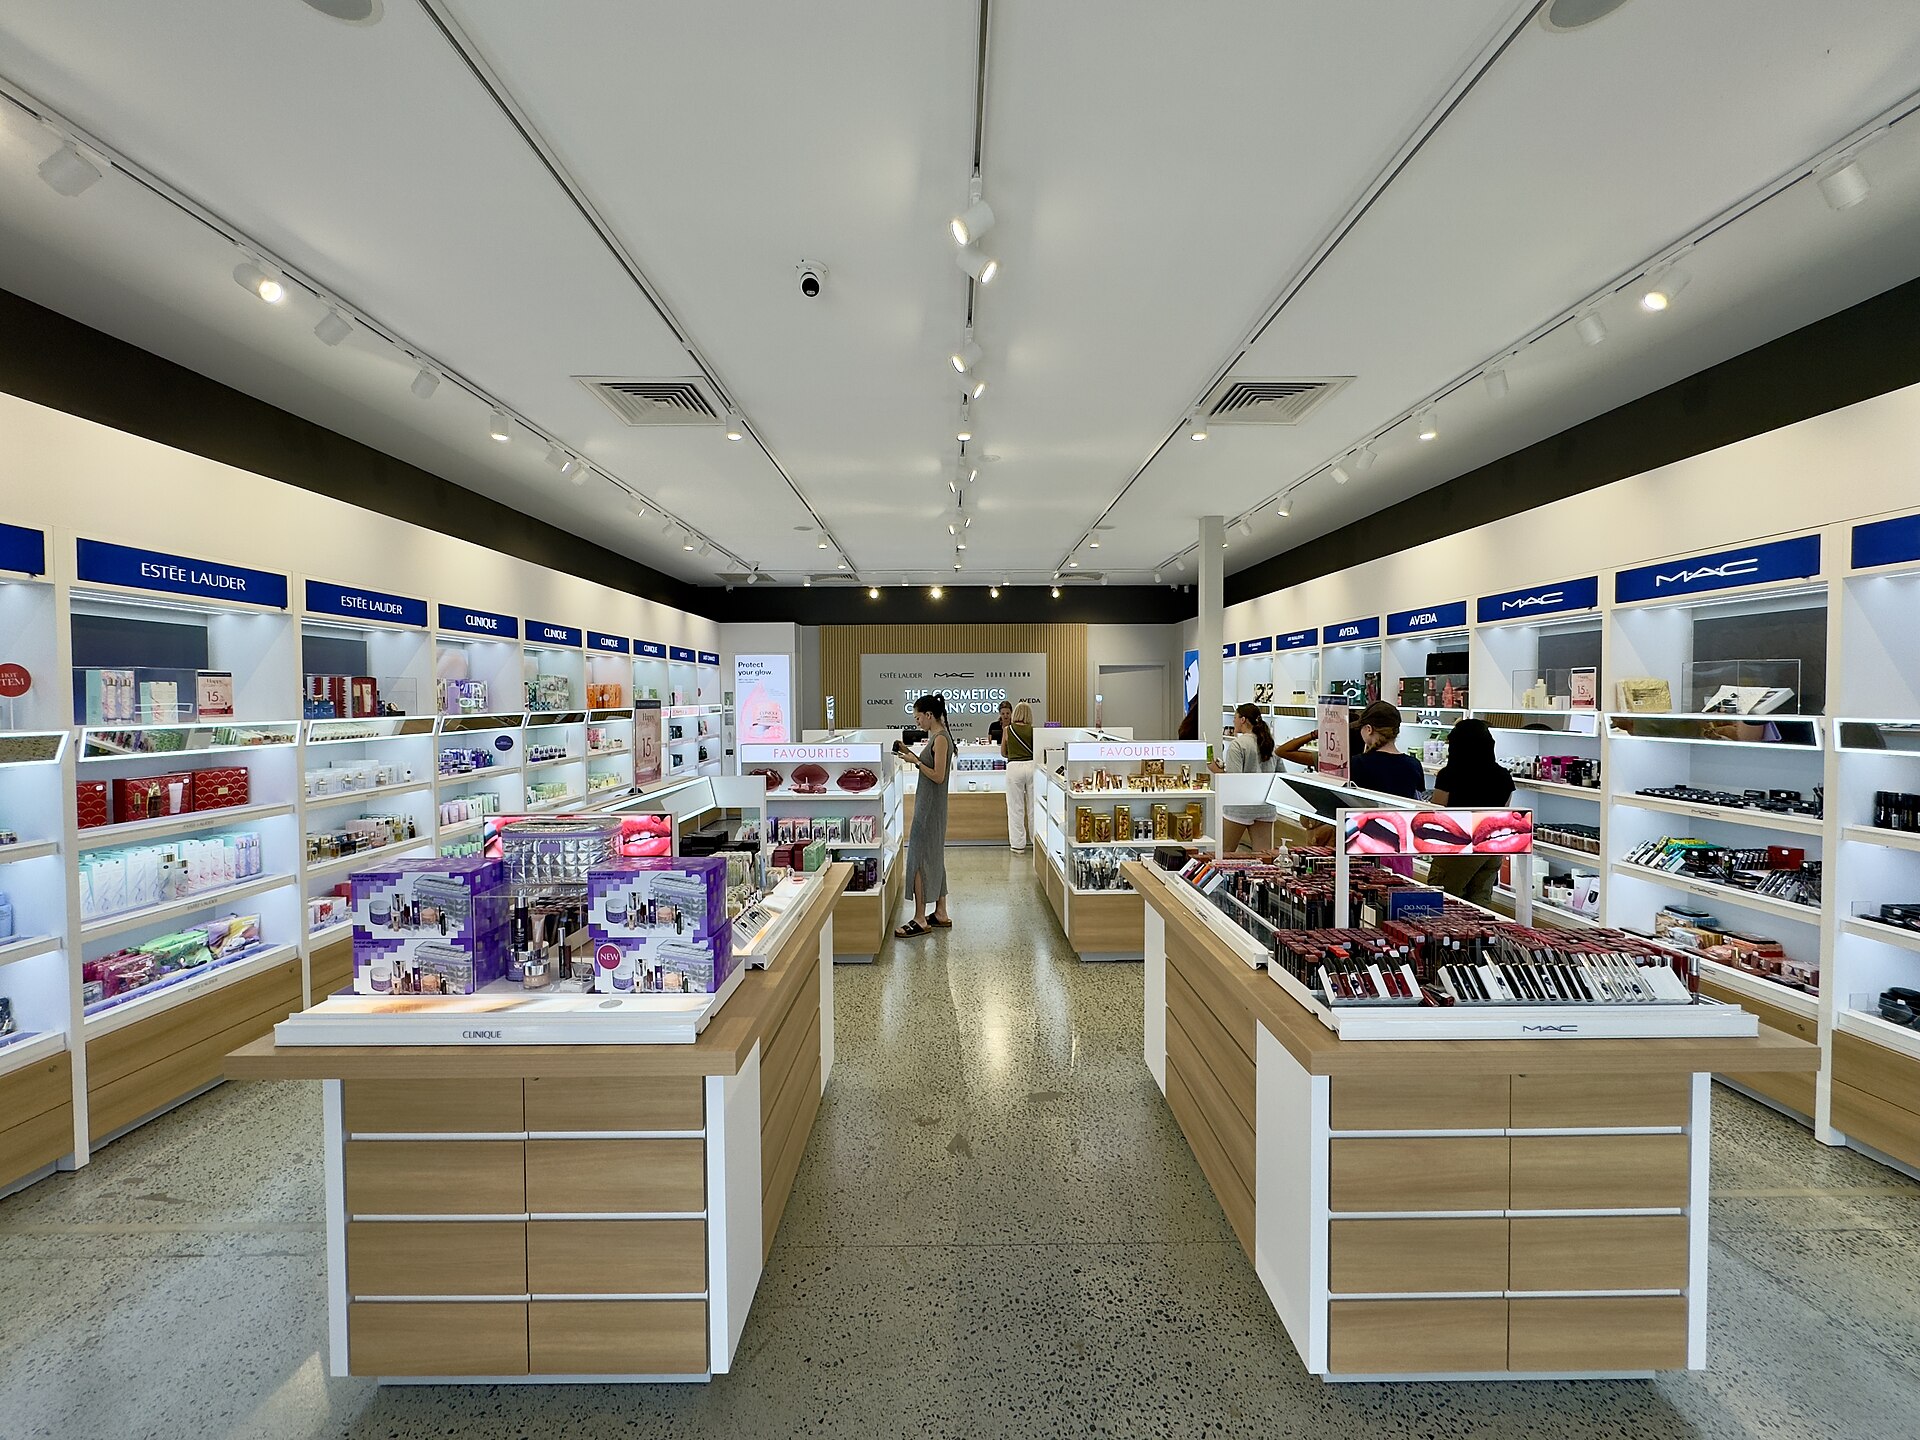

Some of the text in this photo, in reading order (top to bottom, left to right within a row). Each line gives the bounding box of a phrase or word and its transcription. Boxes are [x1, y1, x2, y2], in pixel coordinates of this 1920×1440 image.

[141, 562, 246, 591] ESTÉE LAUDER
[1656, 558, 1758, 587] MAC
[1502, 591, 1564, 611] MAC
[369, 600, 403, 615] LAUDER
[465, 614, 498, 630] CLINIQUE
[1409, 612, 1438, 627] AVEDA
[544, 628, 567, 640] CLINIQUE
[1338, 626, 1360, 637] AVEDA
[600, 637, 619, 648] CLINIQUE
[0, 677, 25, 686] TEM
[207, 690, 219, 702] 15
[904, 688, 1006, 700] THE COSMETICS
[1577, 685, 1586, 695] 15
[904, 702, 1001, 714] CANY STOR
[1325, 731, 1336, 751] 15
[642, 737, 652, 758] 15
[773, 748, 849, 759] FAVOURITES
[1100, 746, 1176, 757] FAVOURITES
[600, 952, 619, 961] NEW
[1522, 1024, 1578, 1033] MAC
[462, 1030, 502, 1040] CLINIQUE
